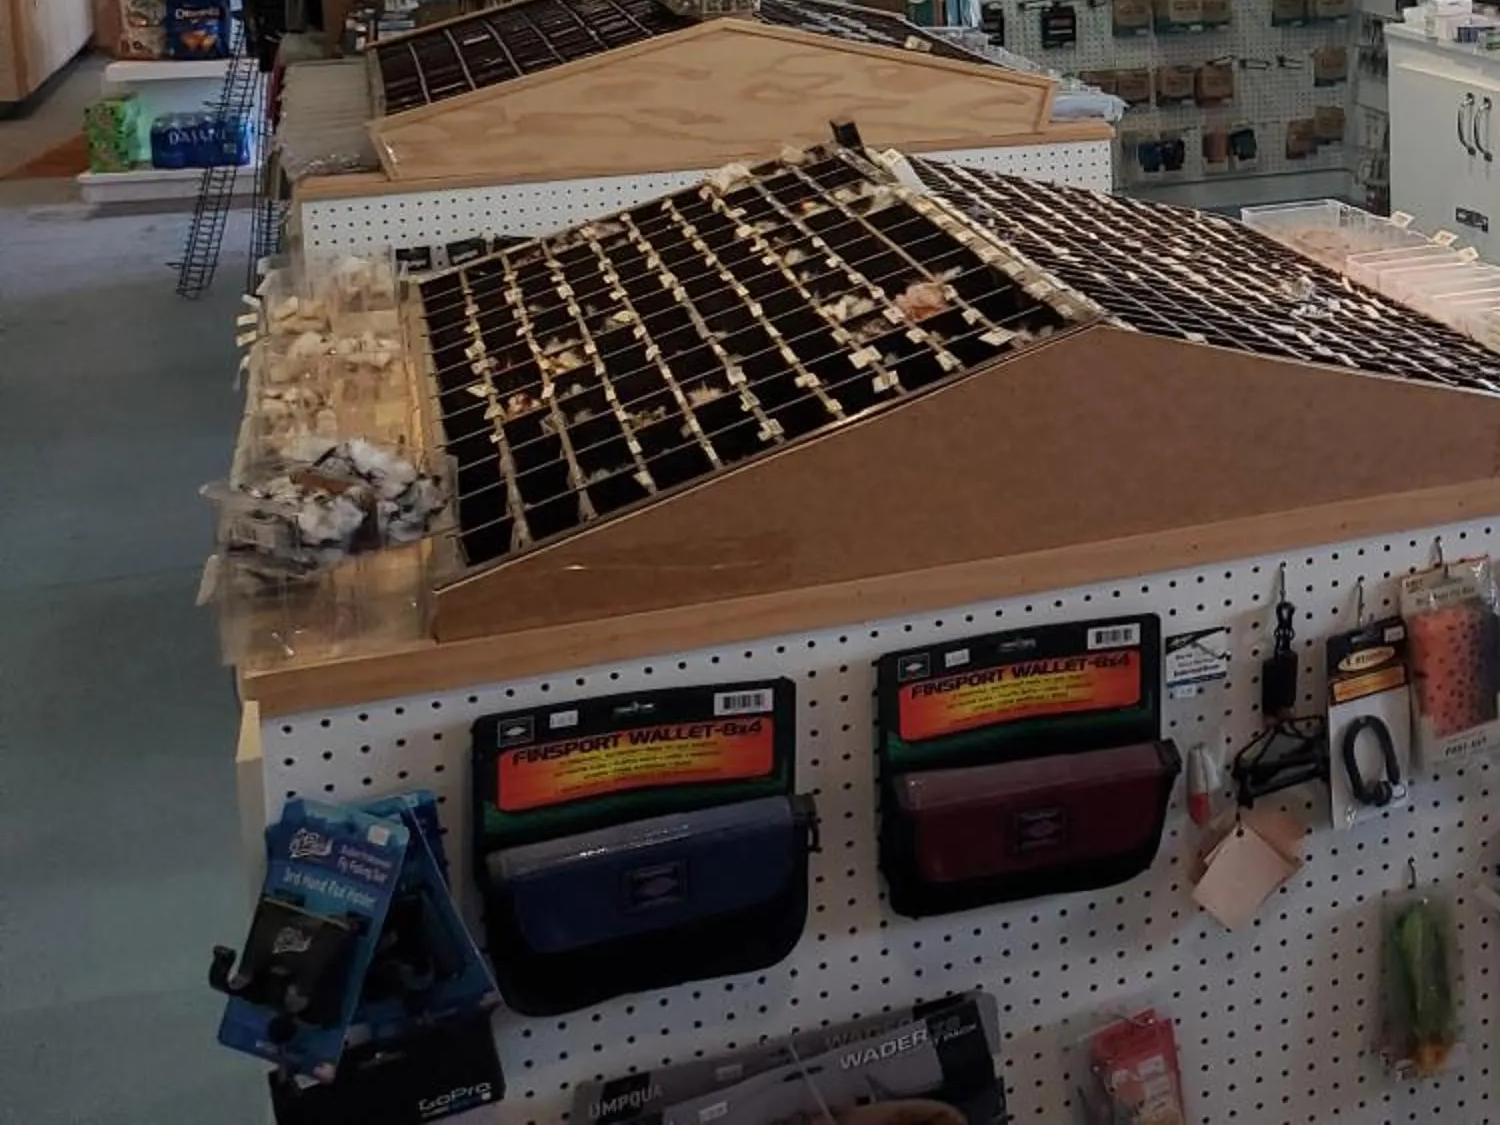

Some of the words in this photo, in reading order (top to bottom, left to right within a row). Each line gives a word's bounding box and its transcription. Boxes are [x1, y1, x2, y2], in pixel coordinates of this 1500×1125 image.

[909, 667, 1005, 700] FINSPORT
[511, 732, 621, 766] FINSPORT
[840, 1028, 929, 1070] WADER
[417, 1082, 493, 1112] GoPro
